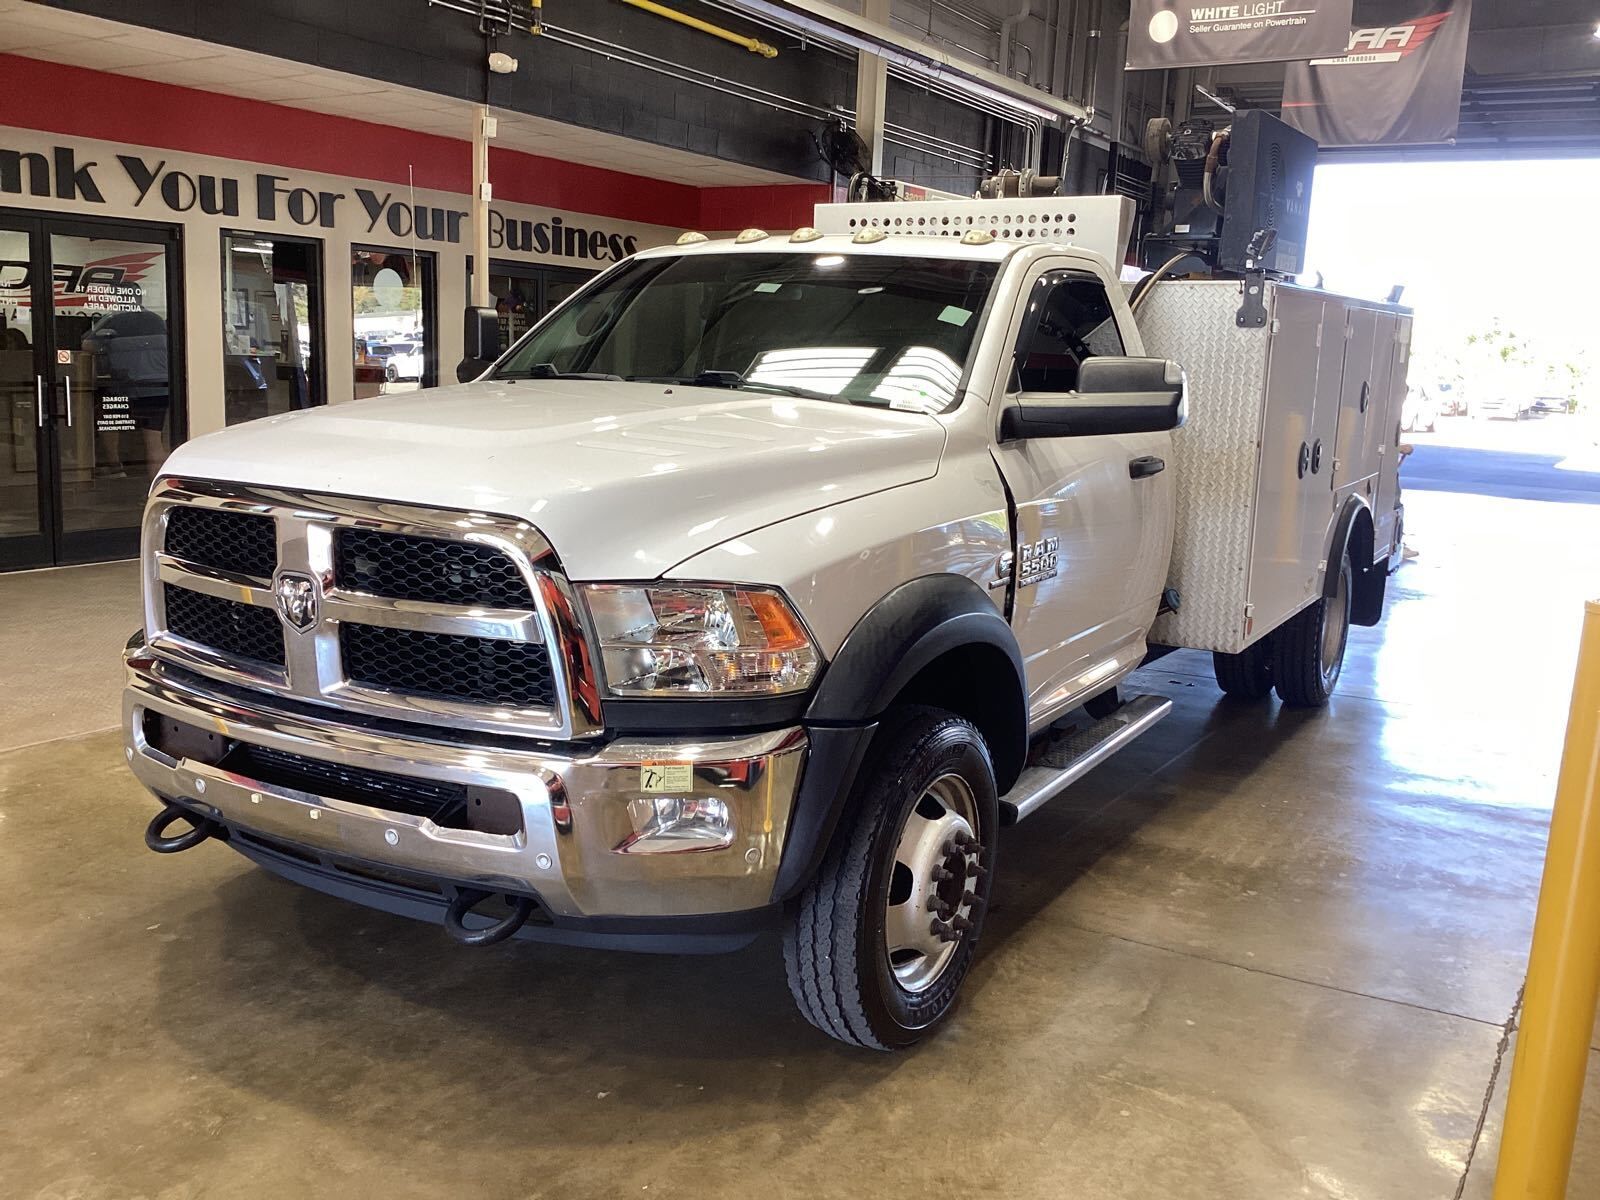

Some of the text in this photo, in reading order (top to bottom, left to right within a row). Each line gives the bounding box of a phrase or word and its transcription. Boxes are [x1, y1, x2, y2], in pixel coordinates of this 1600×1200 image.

[1191, 1, 1285, 20] WHITE LIGHT
[1189, 16, 1307, 34] Seller Guarantee on Powertrain
[1347, 25, 1416, 51] AA
[117, 154, 239, 217] You
[257, 173, 345, 228] For
[354, 188, 468, 243] Your
[1021, 536, 1059, 561] RAM
[1021, 552, 1058, 577] 5500
